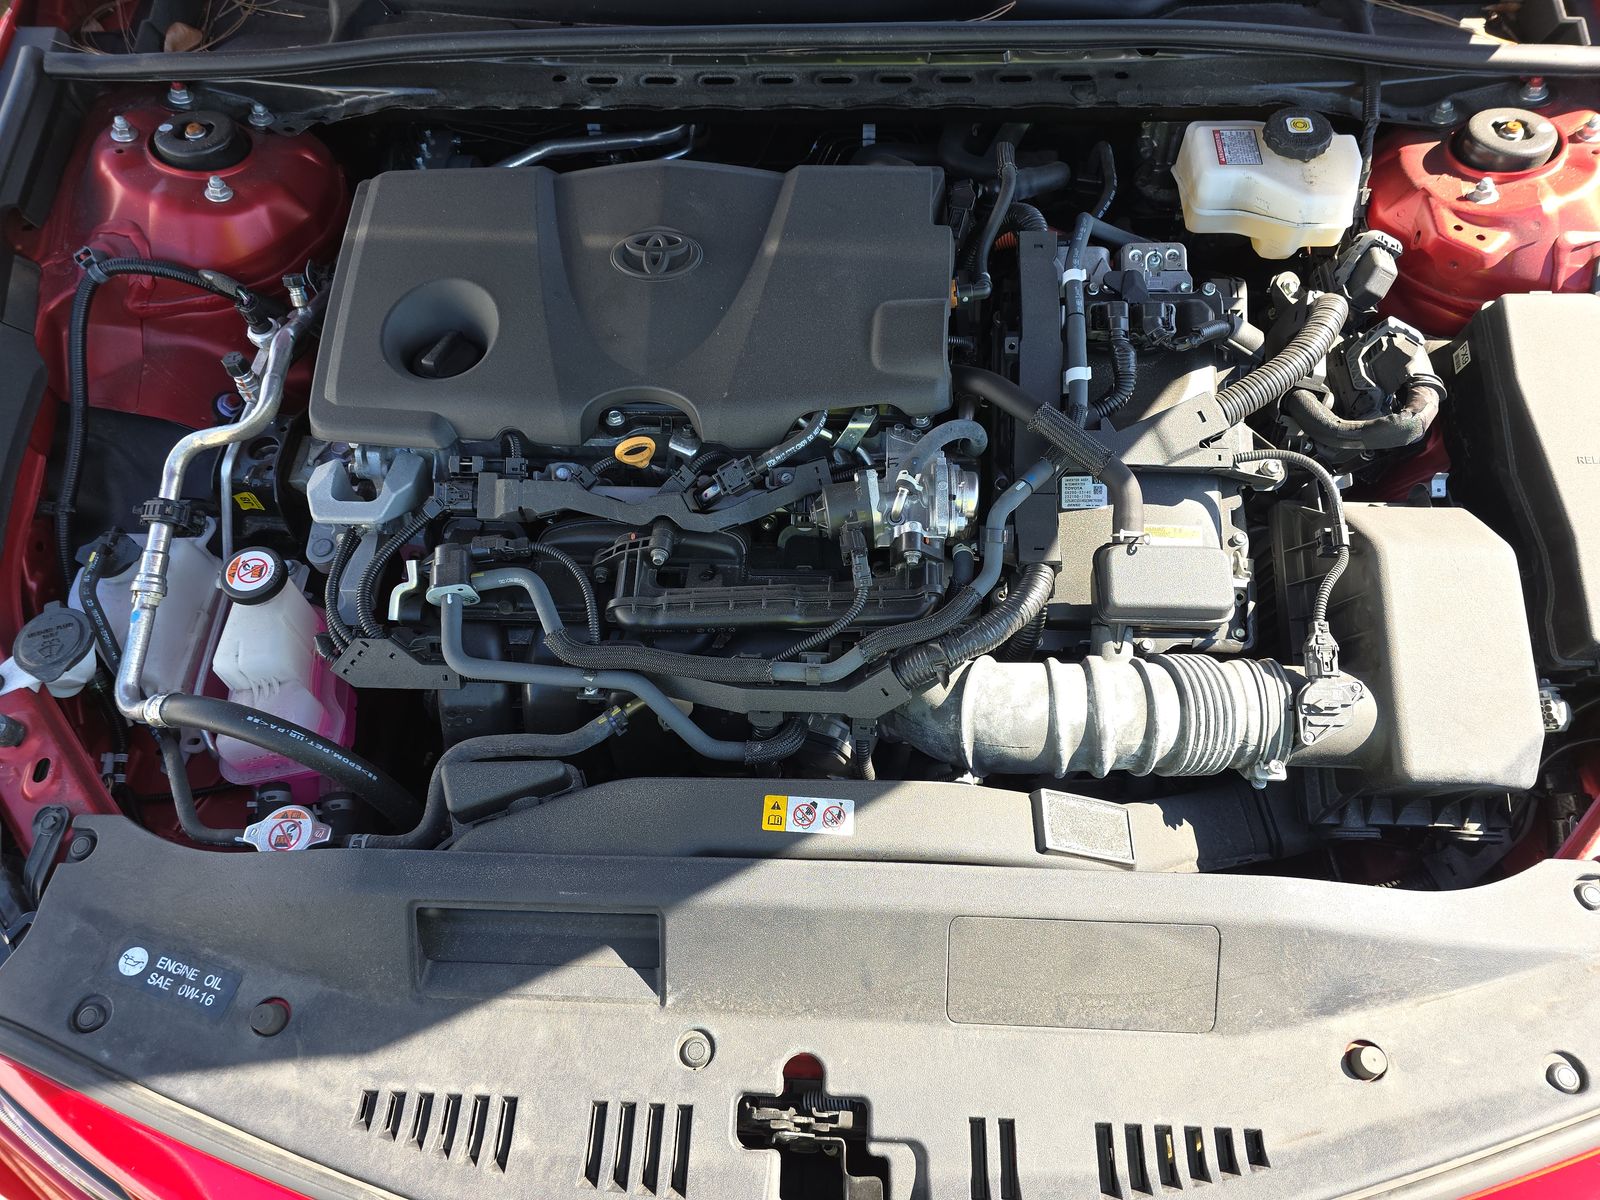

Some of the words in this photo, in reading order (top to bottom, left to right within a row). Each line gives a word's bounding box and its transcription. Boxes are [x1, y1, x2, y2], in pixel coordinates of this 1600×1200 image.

[1576, 455, 1600, 464] REL
[147, 972, 174, 991] SAE
[177, 984, 215, 1006] 0W-16
[156, 956, 201, 981] ENGINE
[204, 974, 222, 991] OIL
